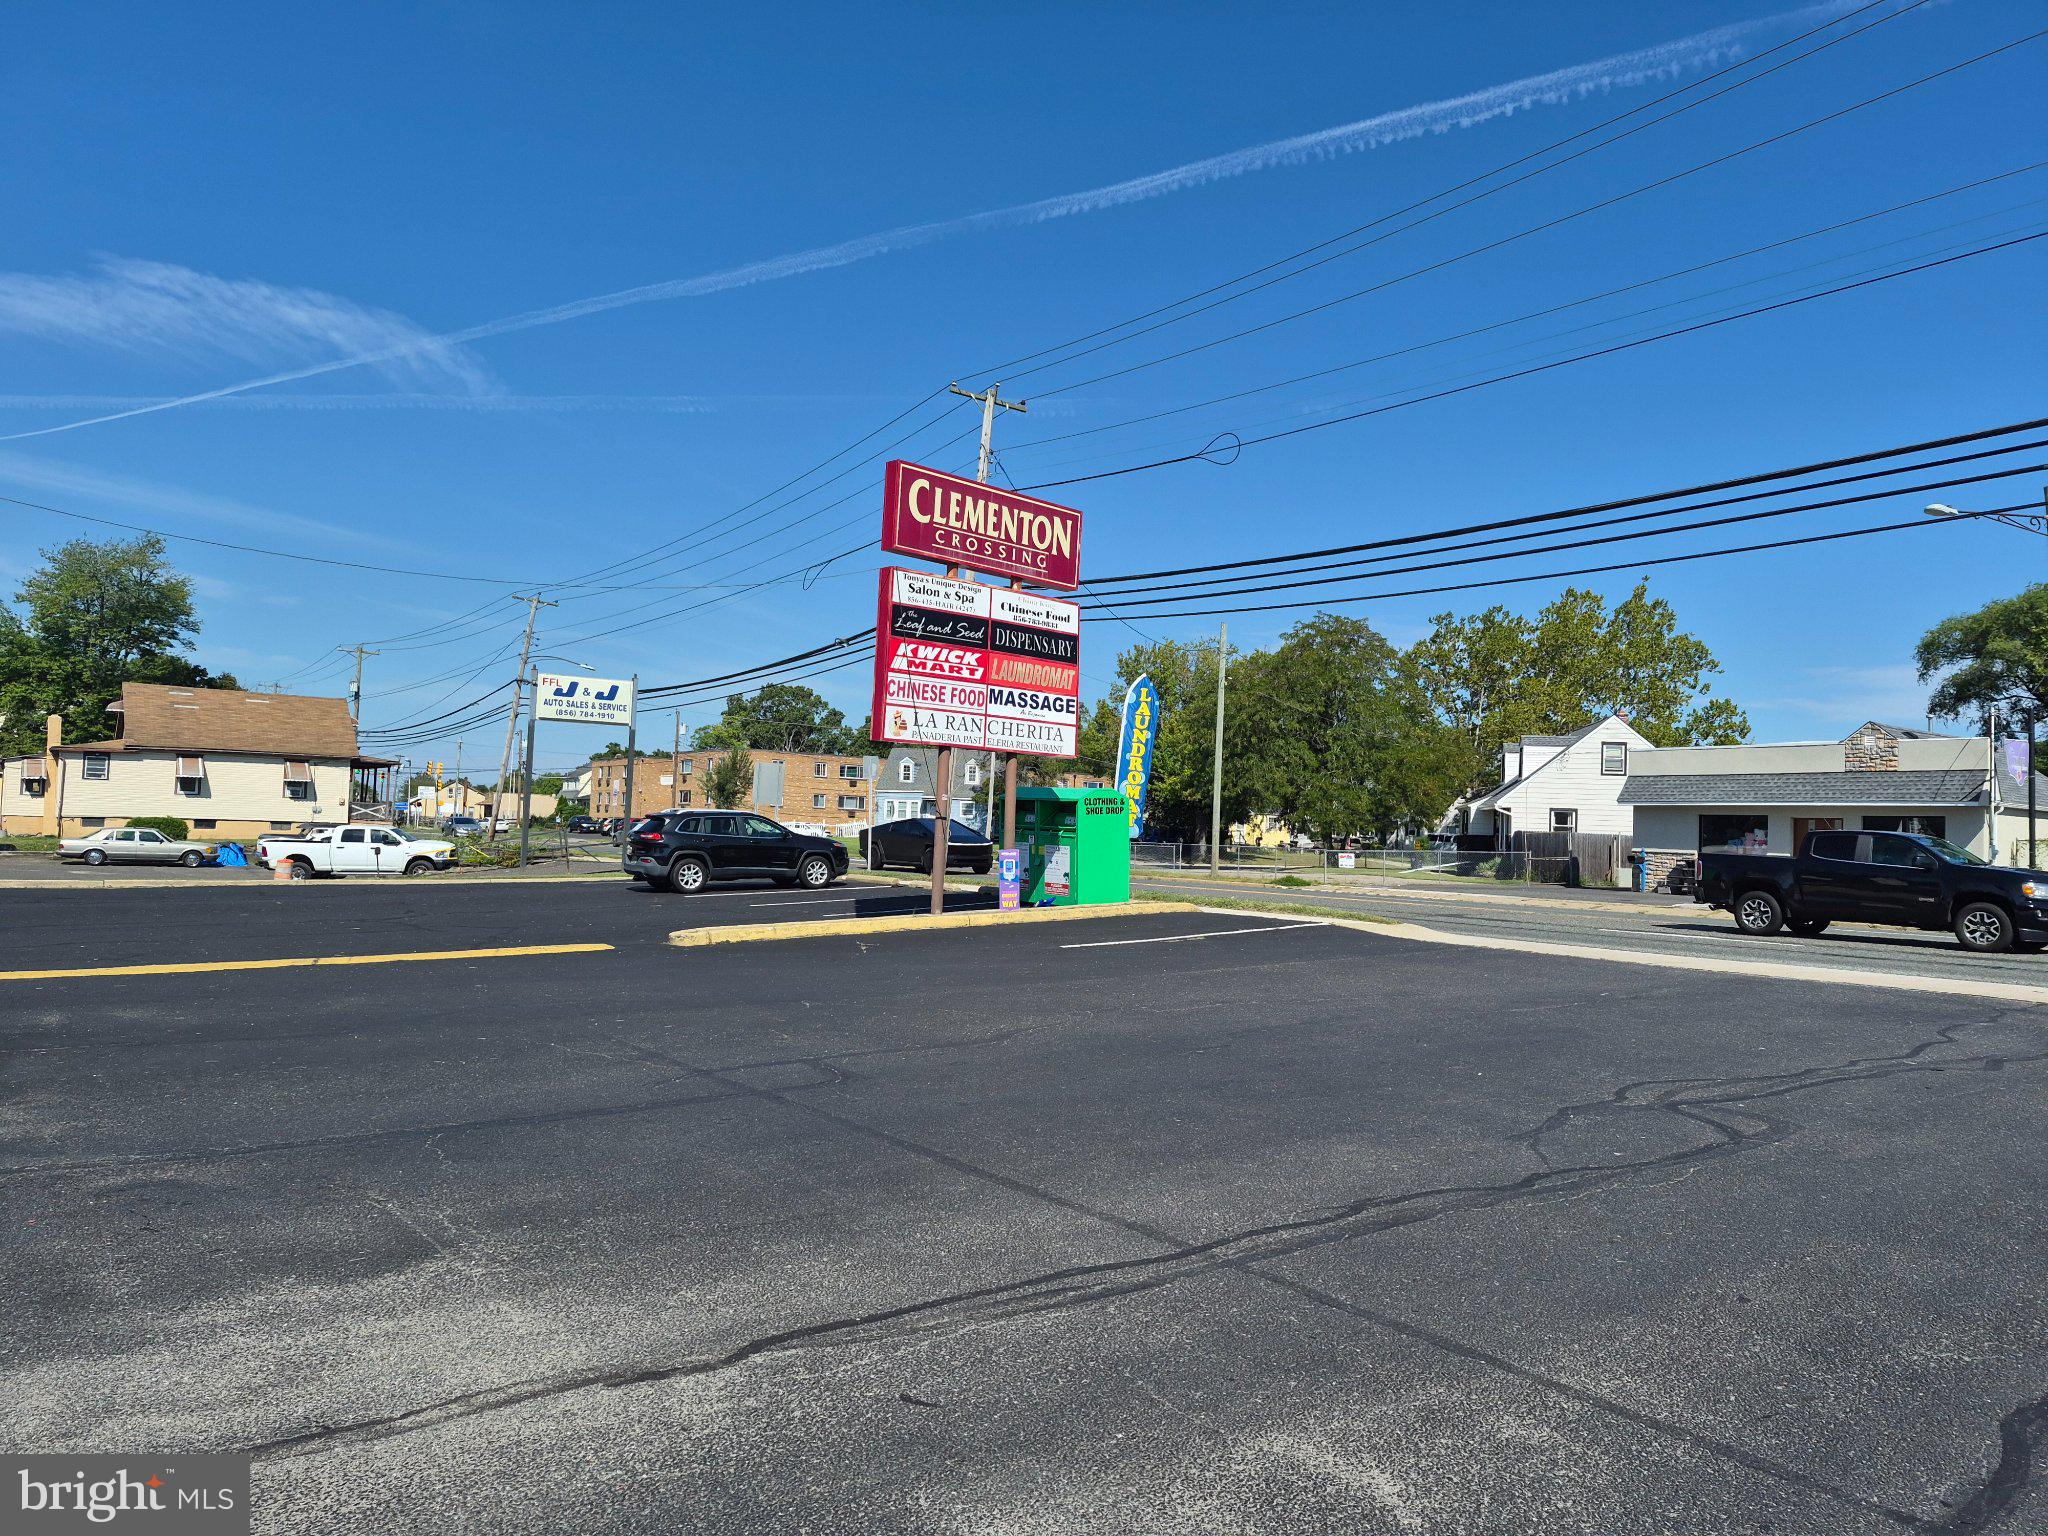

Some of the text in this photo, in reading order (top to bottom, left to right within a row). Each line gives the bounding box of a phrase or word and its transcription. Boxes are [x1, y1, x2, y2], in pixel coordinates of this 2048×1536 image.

[908, 478, 1073, 560] CLEMENTON
[935, 530, 1047, 568] CROSSING
[908, 582, 975, 605] Salon & Spa
[931, 578, 956, 589] Unique
[958, 583, 982, 594] Design
[1000, 601, 1071, 623] Chinese Food
[894, 612, 985, 639] Leaf and Seed
[995, 628, 1074, 657] DISPENSARY
[896, 643, 983, 666] KWICK
[908, 660, 980, 677] MART
[991, 658, 1076, 690] LAUNDROMAT
[542, 677, 562, 687] FFL
[553, 681, 619, 701] J & J
[887, 679, 985, 708] CHINESE FOOD
[543, 698, 628, 712] AUTO SALES & SERVICE
[988, 688, 1076, 714] MASSAGE
[555, 708, 615, 720] (856) 784-1910
[913, 711, 938, 729] LA
[987, 719, 1065, 742] CHERITA
[911, 730, 962, 743] PANADERIA
[1015, 740, 1064, 754] RESTAURANT
[1125, 687, 1152, 827] LAUNDROMAT
[1084, 797, 1125, 806] CLOTHING &
[1085, 806, 1125, 815] SHOE DROP
